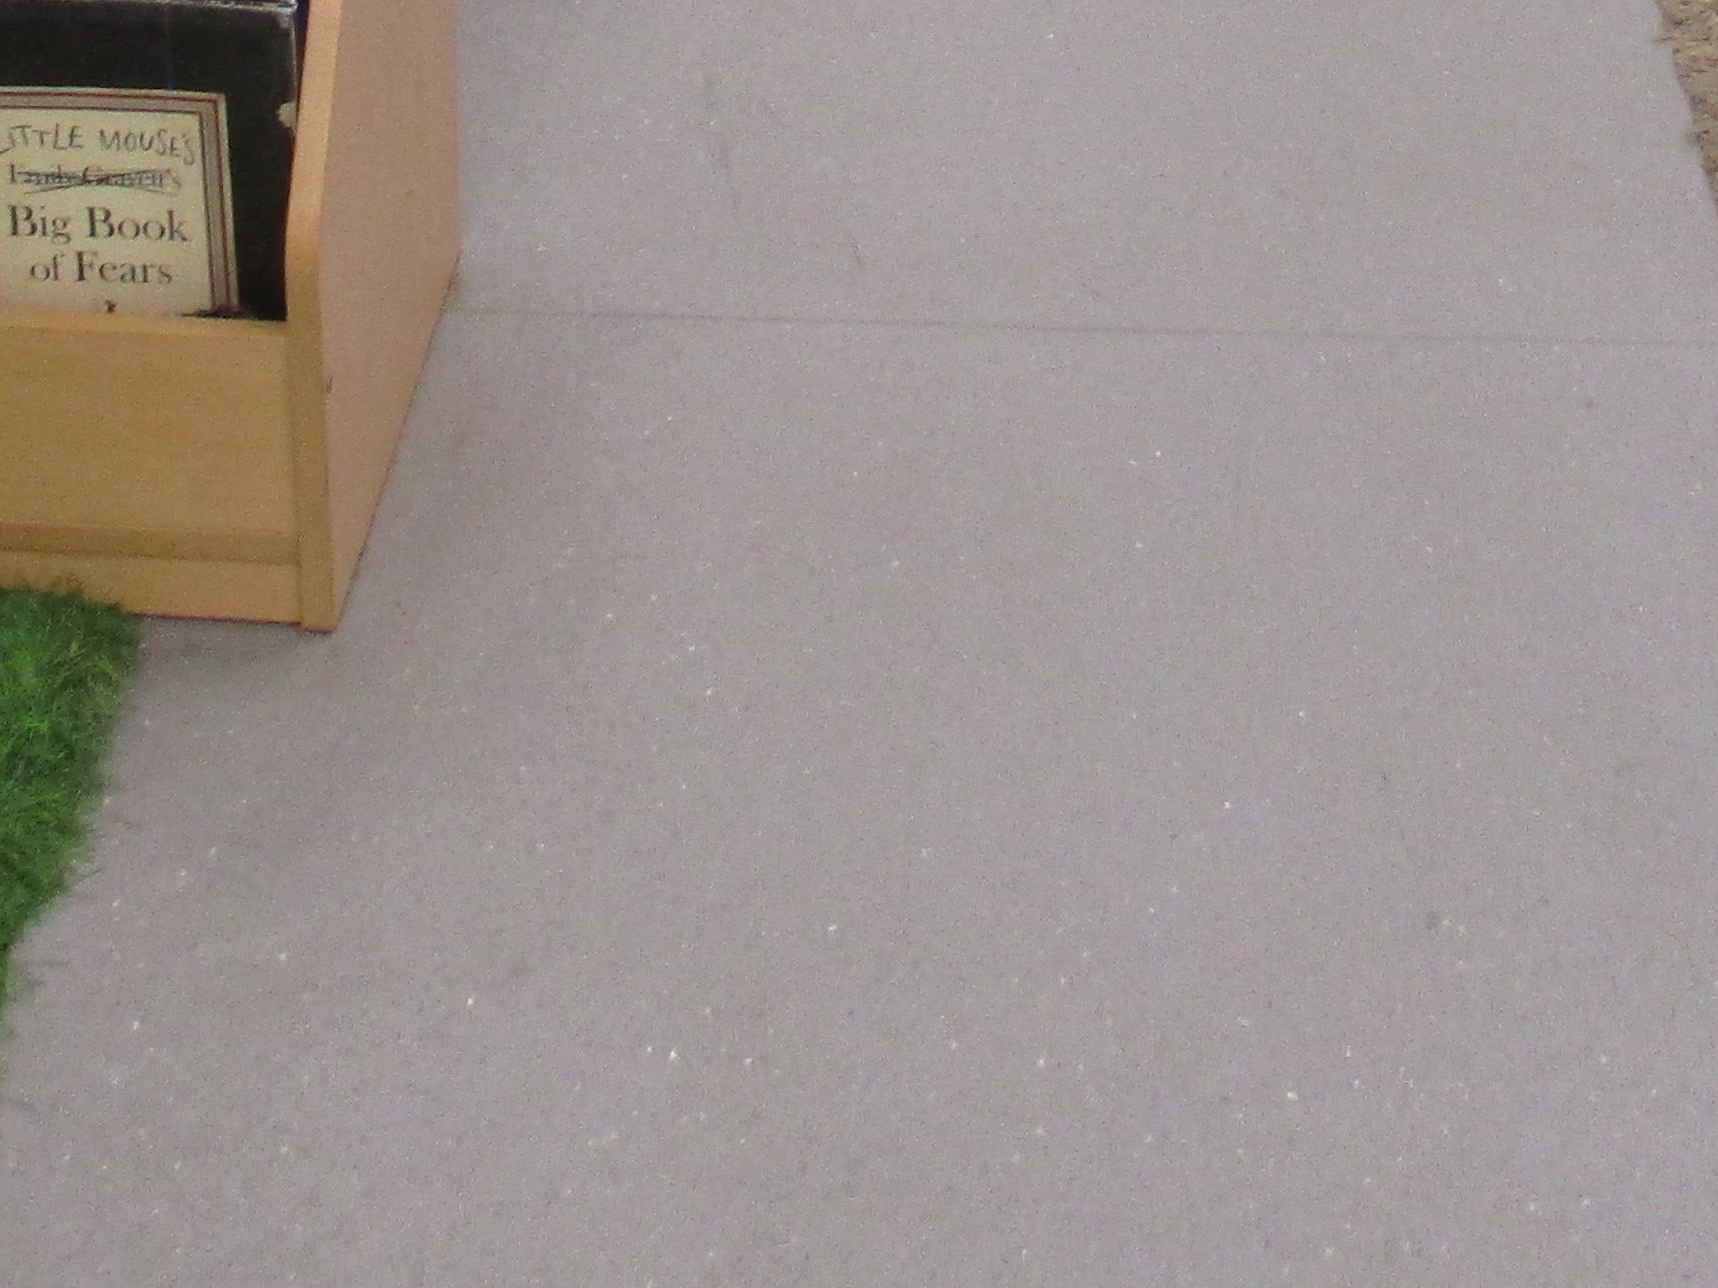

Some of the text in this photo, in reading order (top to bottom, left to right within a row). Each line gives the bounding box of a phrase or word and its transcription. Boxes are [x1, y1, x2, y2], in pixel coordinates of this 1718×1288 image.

[98, 128, 196, 166] MOUSE'S
[7, 204, 190, 245] Big Book
[29, 250, 173, 285] of Fears
